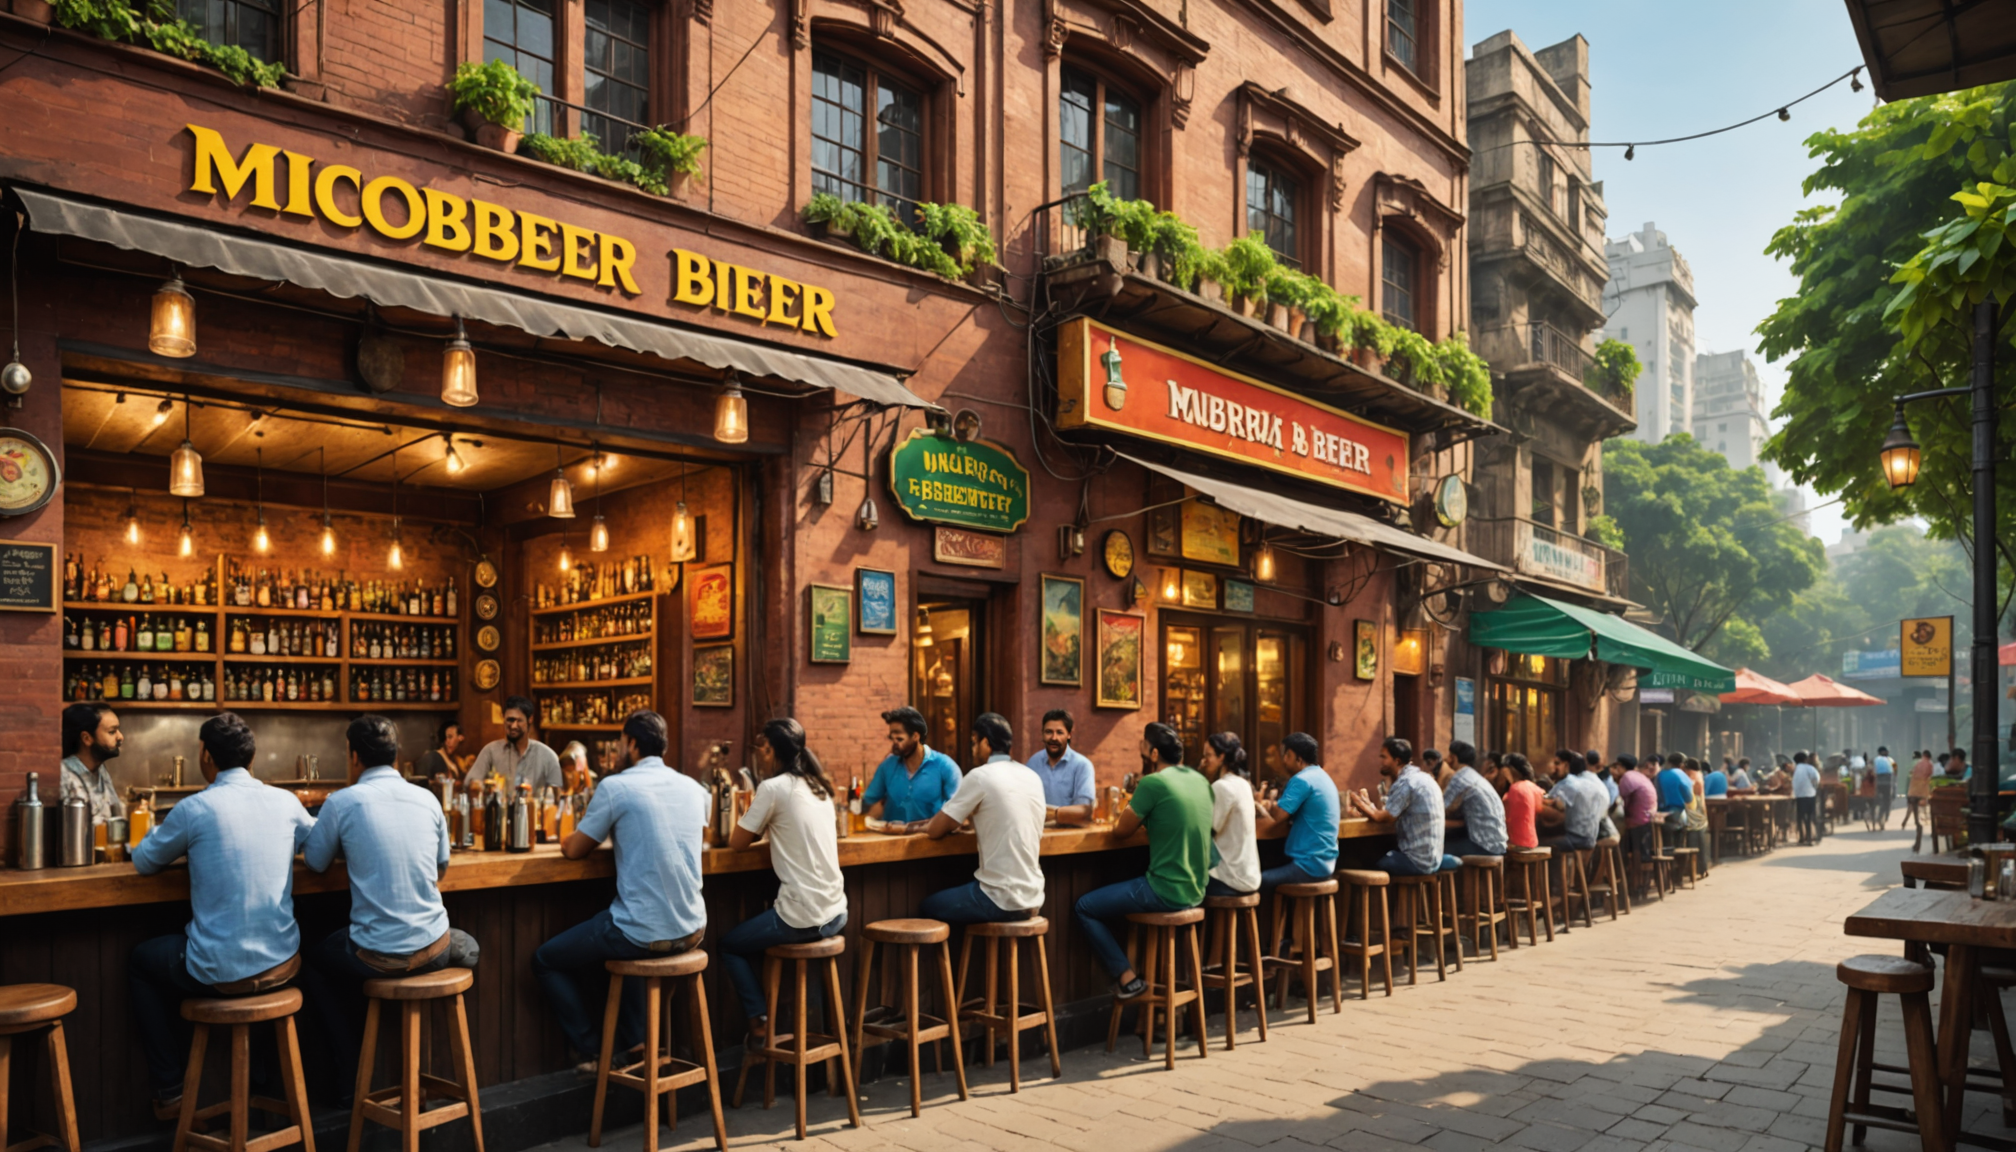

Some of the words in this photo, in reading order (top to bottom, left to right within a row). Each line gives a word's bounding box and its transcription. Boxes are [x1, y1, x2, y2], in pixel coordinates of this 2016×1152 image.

[187, 123, 642, 294] MICOBBEER
[672, 248, 838, 337] BIEER
[1311, 426, 1371, 475] BEER
